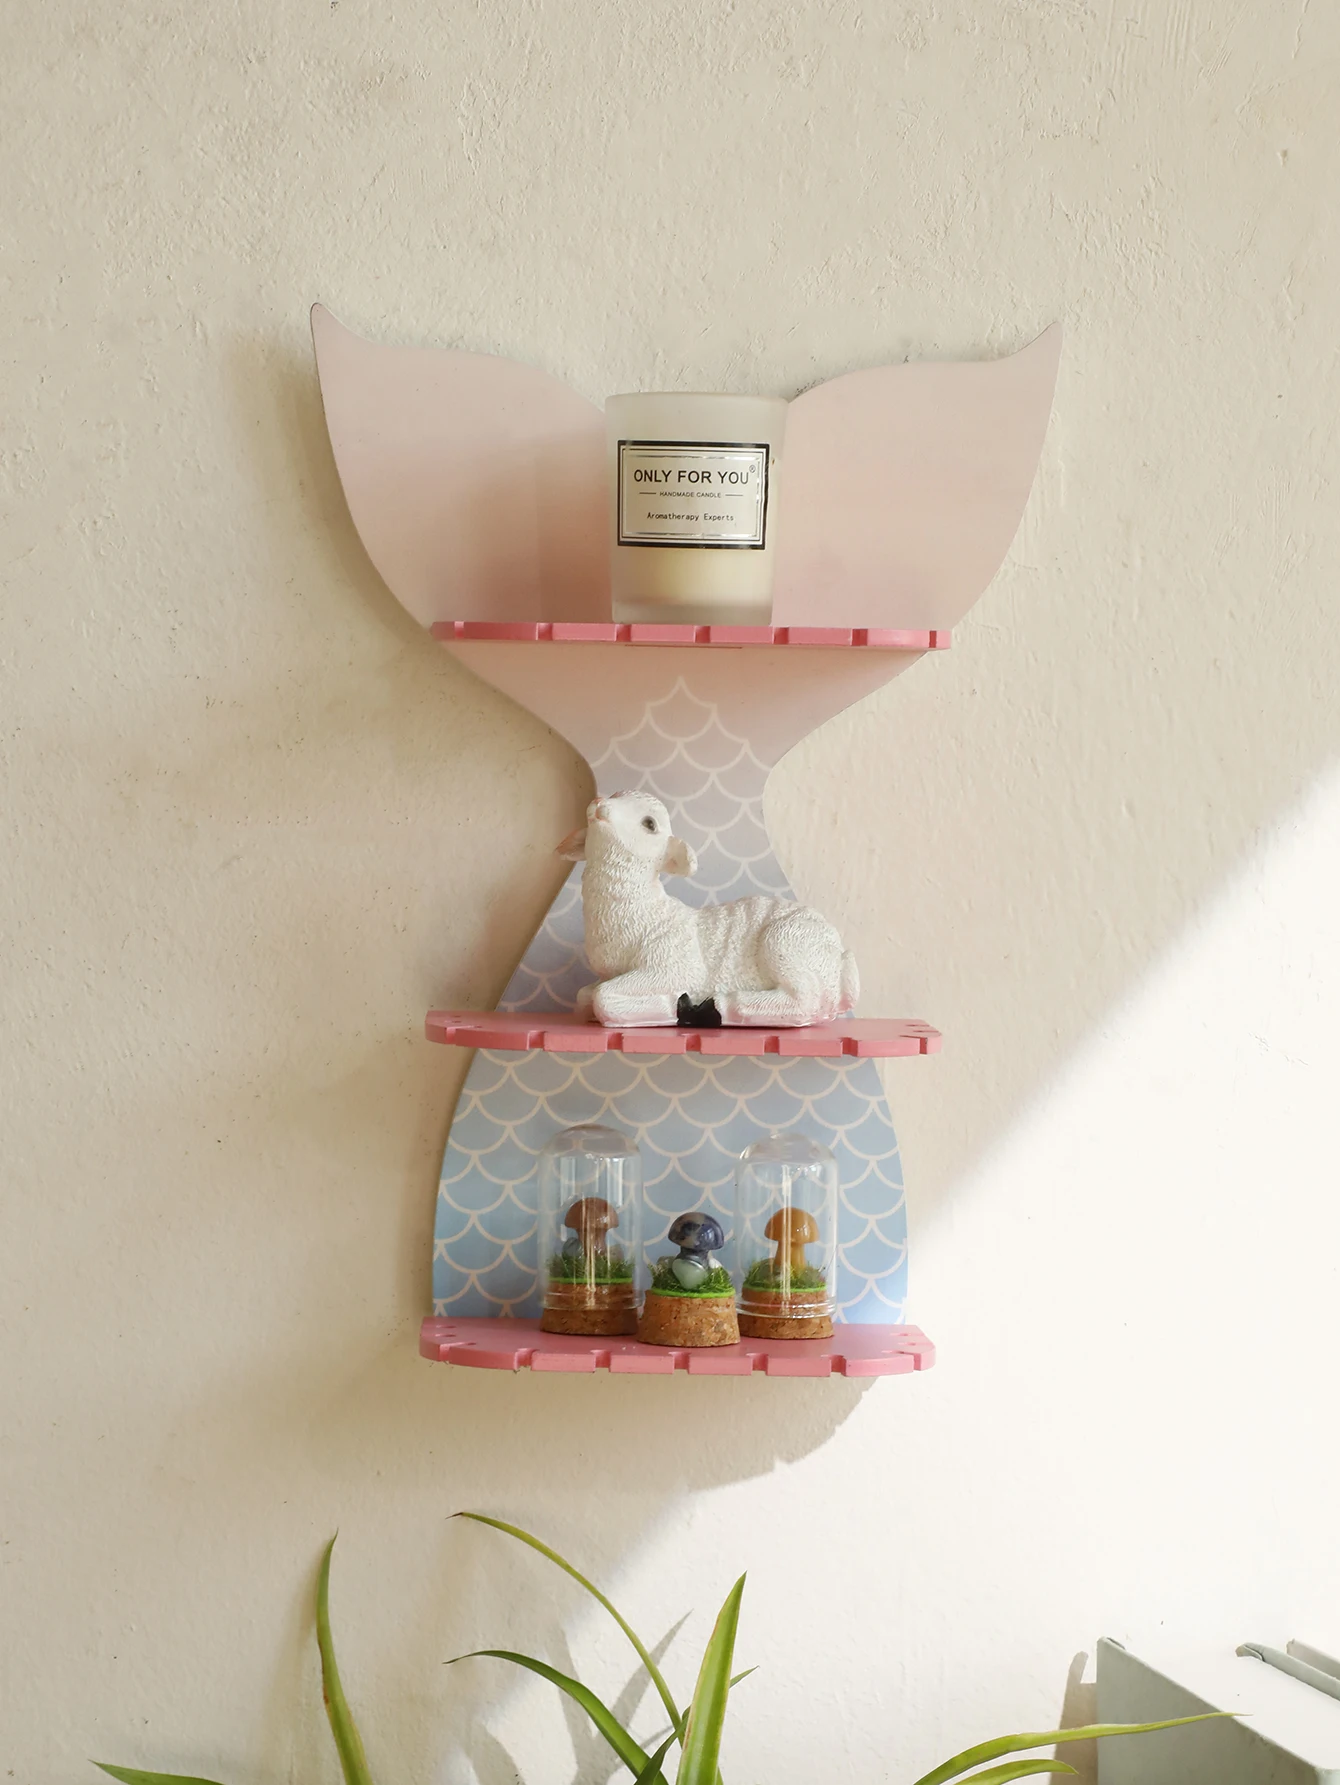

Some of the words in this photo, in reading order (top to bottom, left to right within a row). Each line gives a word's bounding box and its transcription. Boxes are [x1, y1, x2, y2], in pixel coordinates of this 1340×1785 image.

[633, 469, 672, 483] ONLY
[677, 470, 712, 484] FOR
[646, 512, 699, 521] Aromatherapy
[703, 513, 734, 521] Experts
